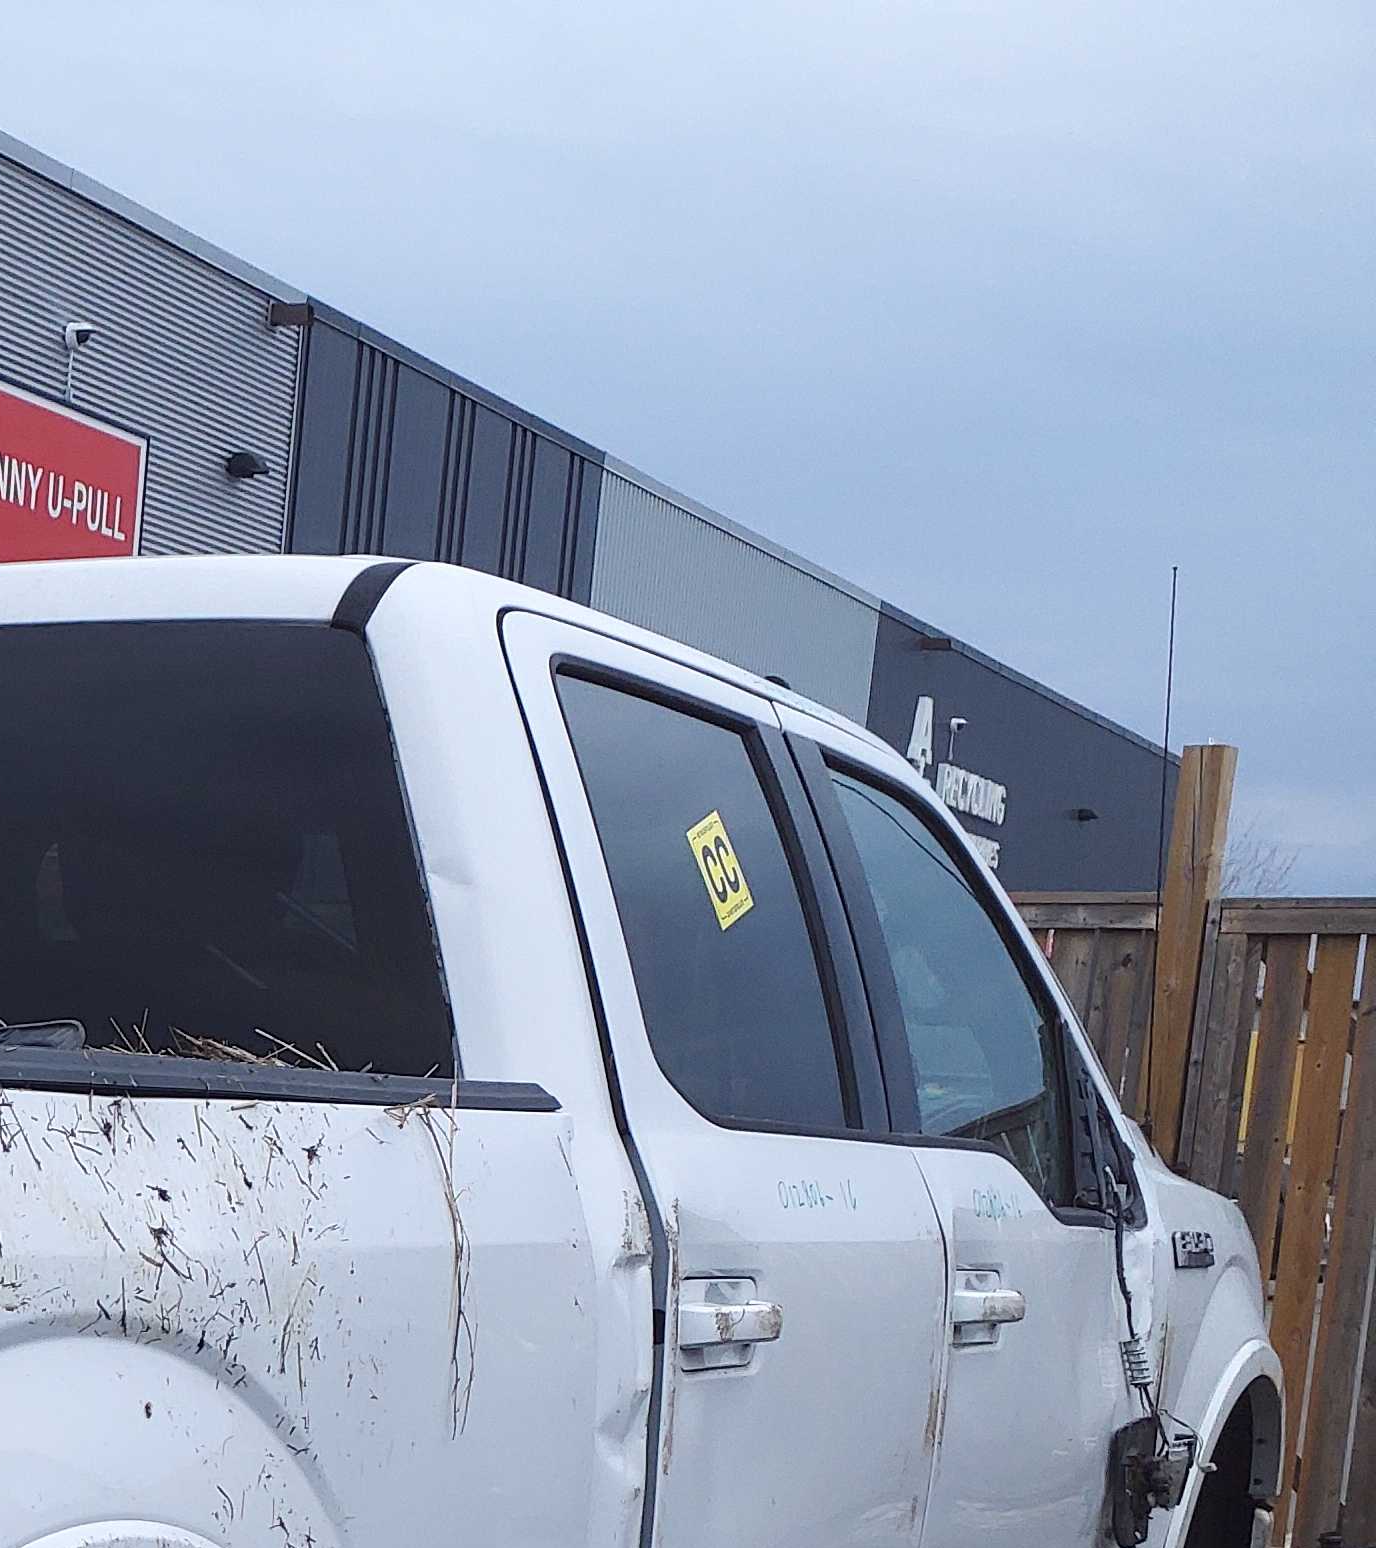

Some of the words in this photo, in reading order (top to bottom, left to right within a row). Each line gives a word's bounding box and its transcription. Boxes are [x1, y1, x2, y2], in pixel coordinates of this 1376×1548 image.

[47, 472, 127, 542] U-PULL
[938, 762, 1006, 826] RECYCLING
[701, 835, 740, 904] CC
